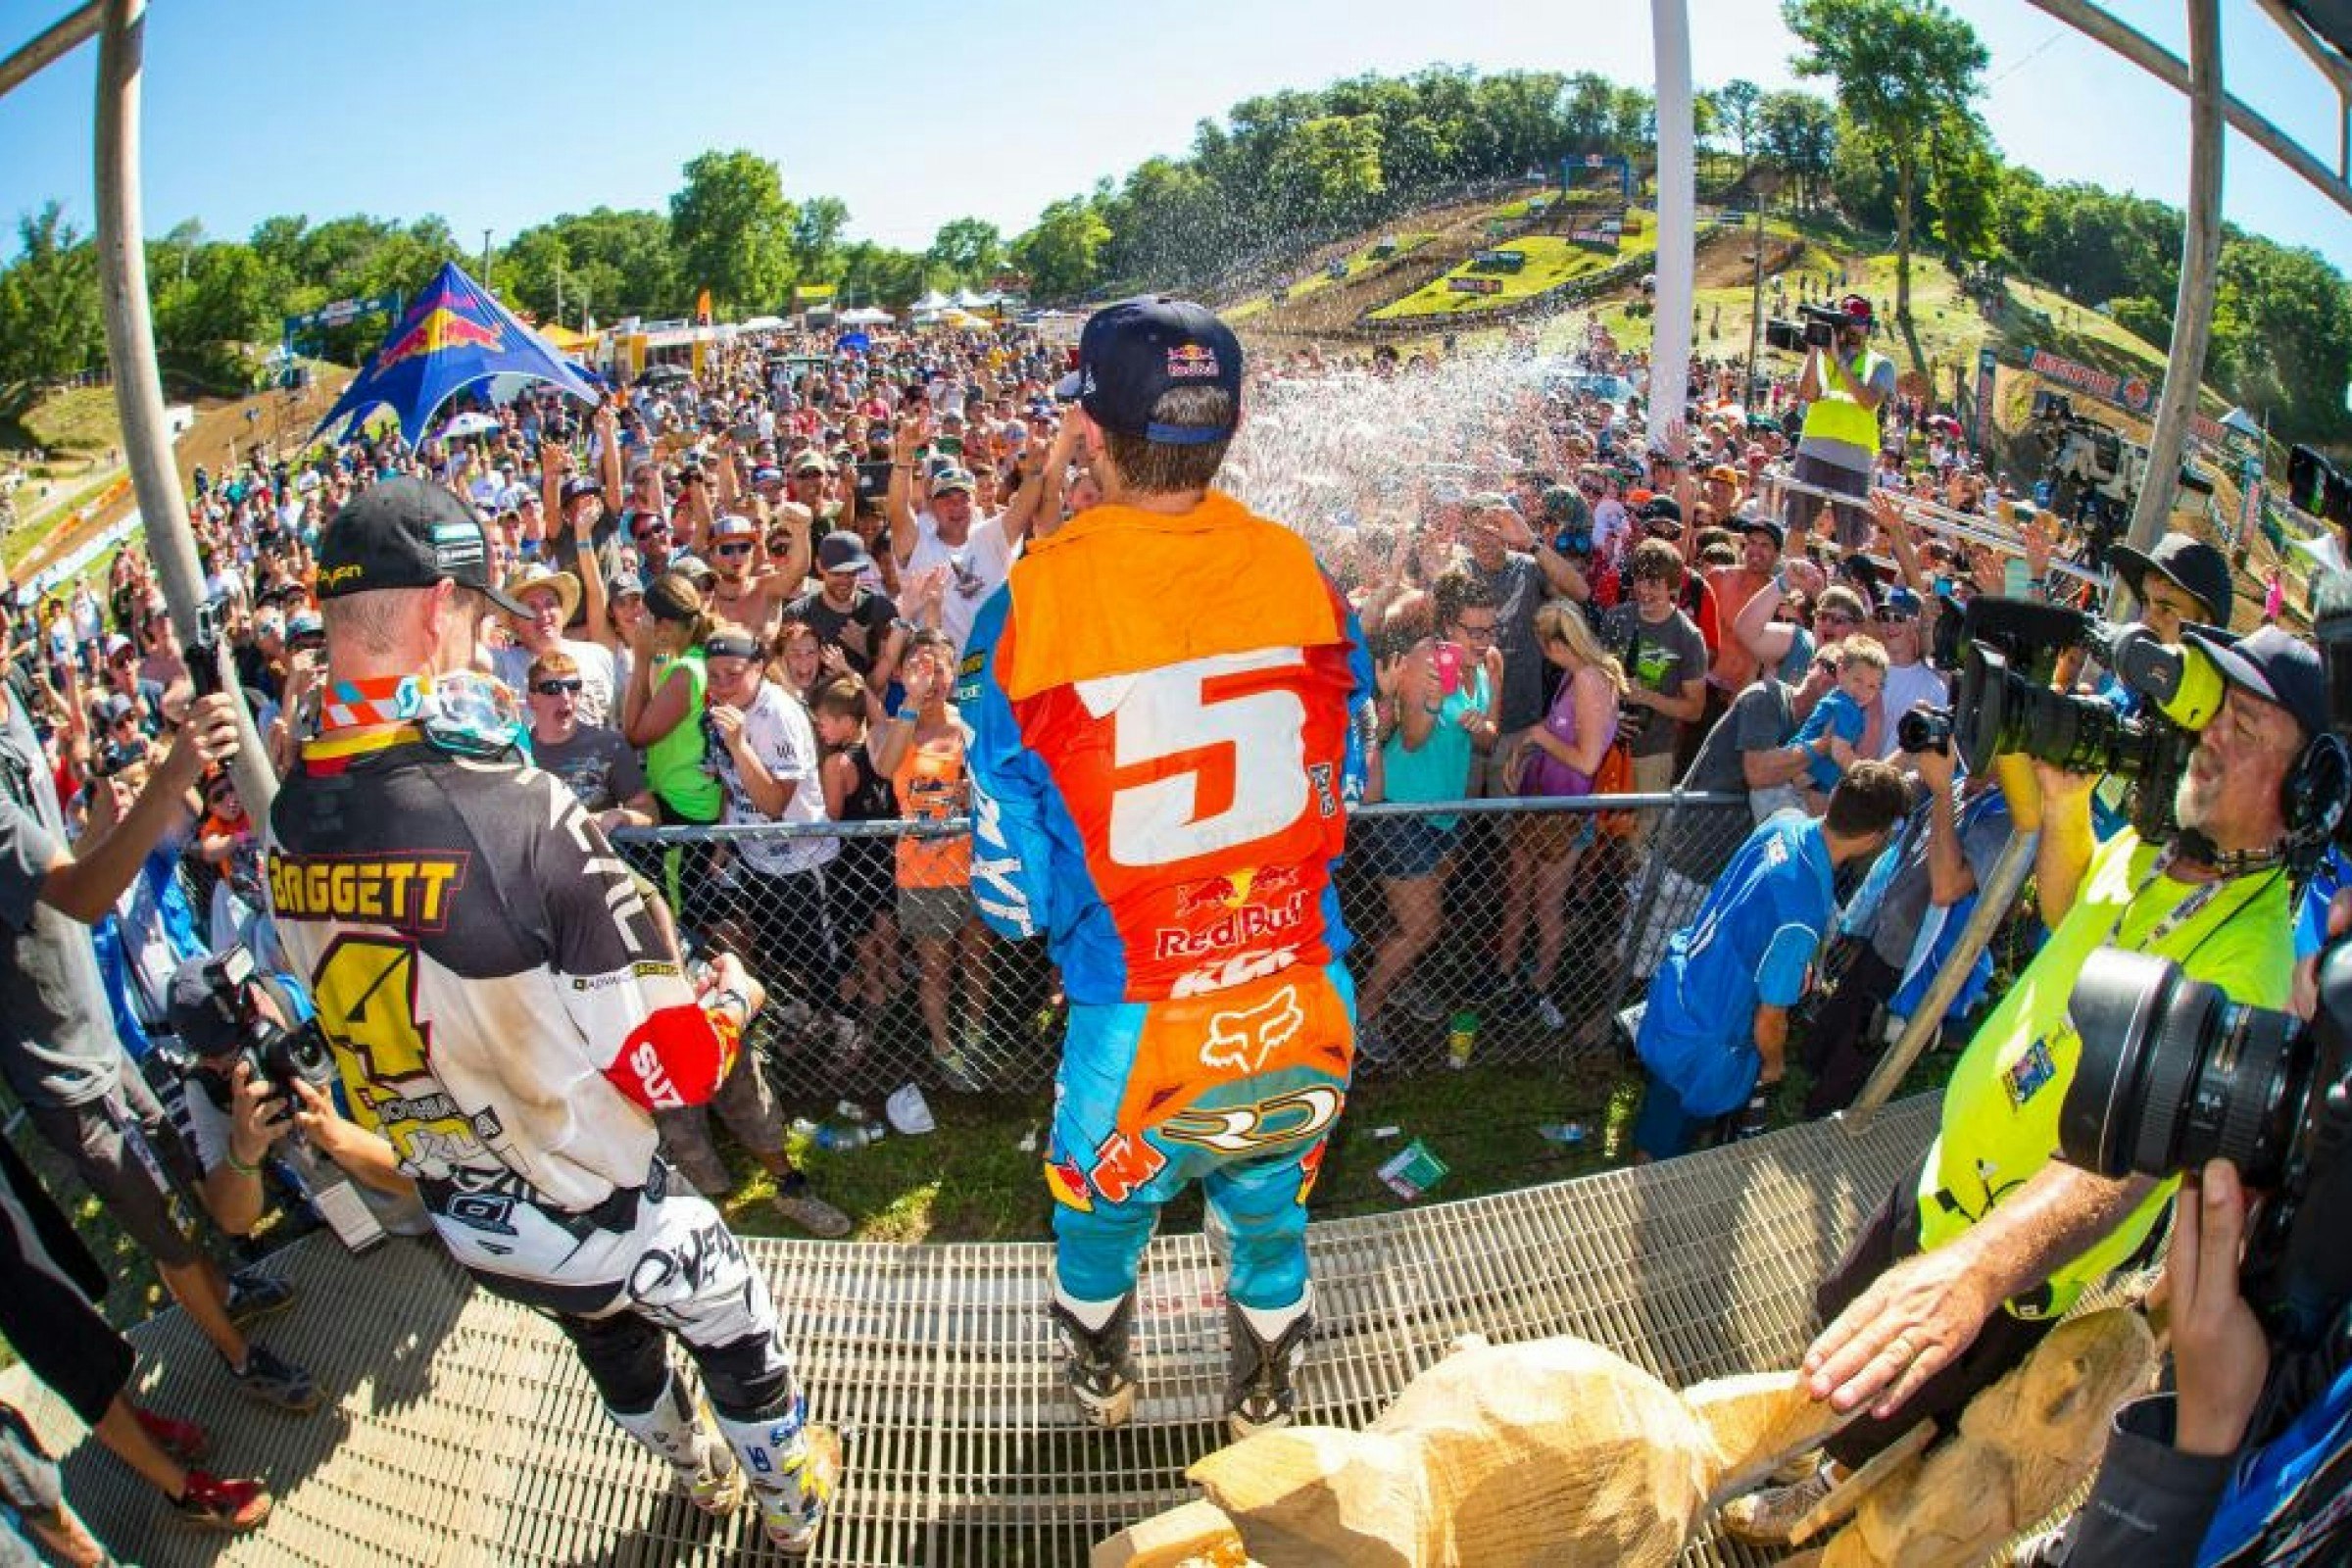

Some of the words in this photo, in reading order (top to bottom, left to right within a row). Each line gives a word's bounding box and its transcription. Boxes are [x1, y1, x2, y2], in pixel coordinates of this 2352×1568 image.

[1073, 646, 1311, 867] 5
[269, 856, 458, 921] BAGGETT
[1154, 913, 1239, 960] Red
[310, 936, 431, 1082] 4
